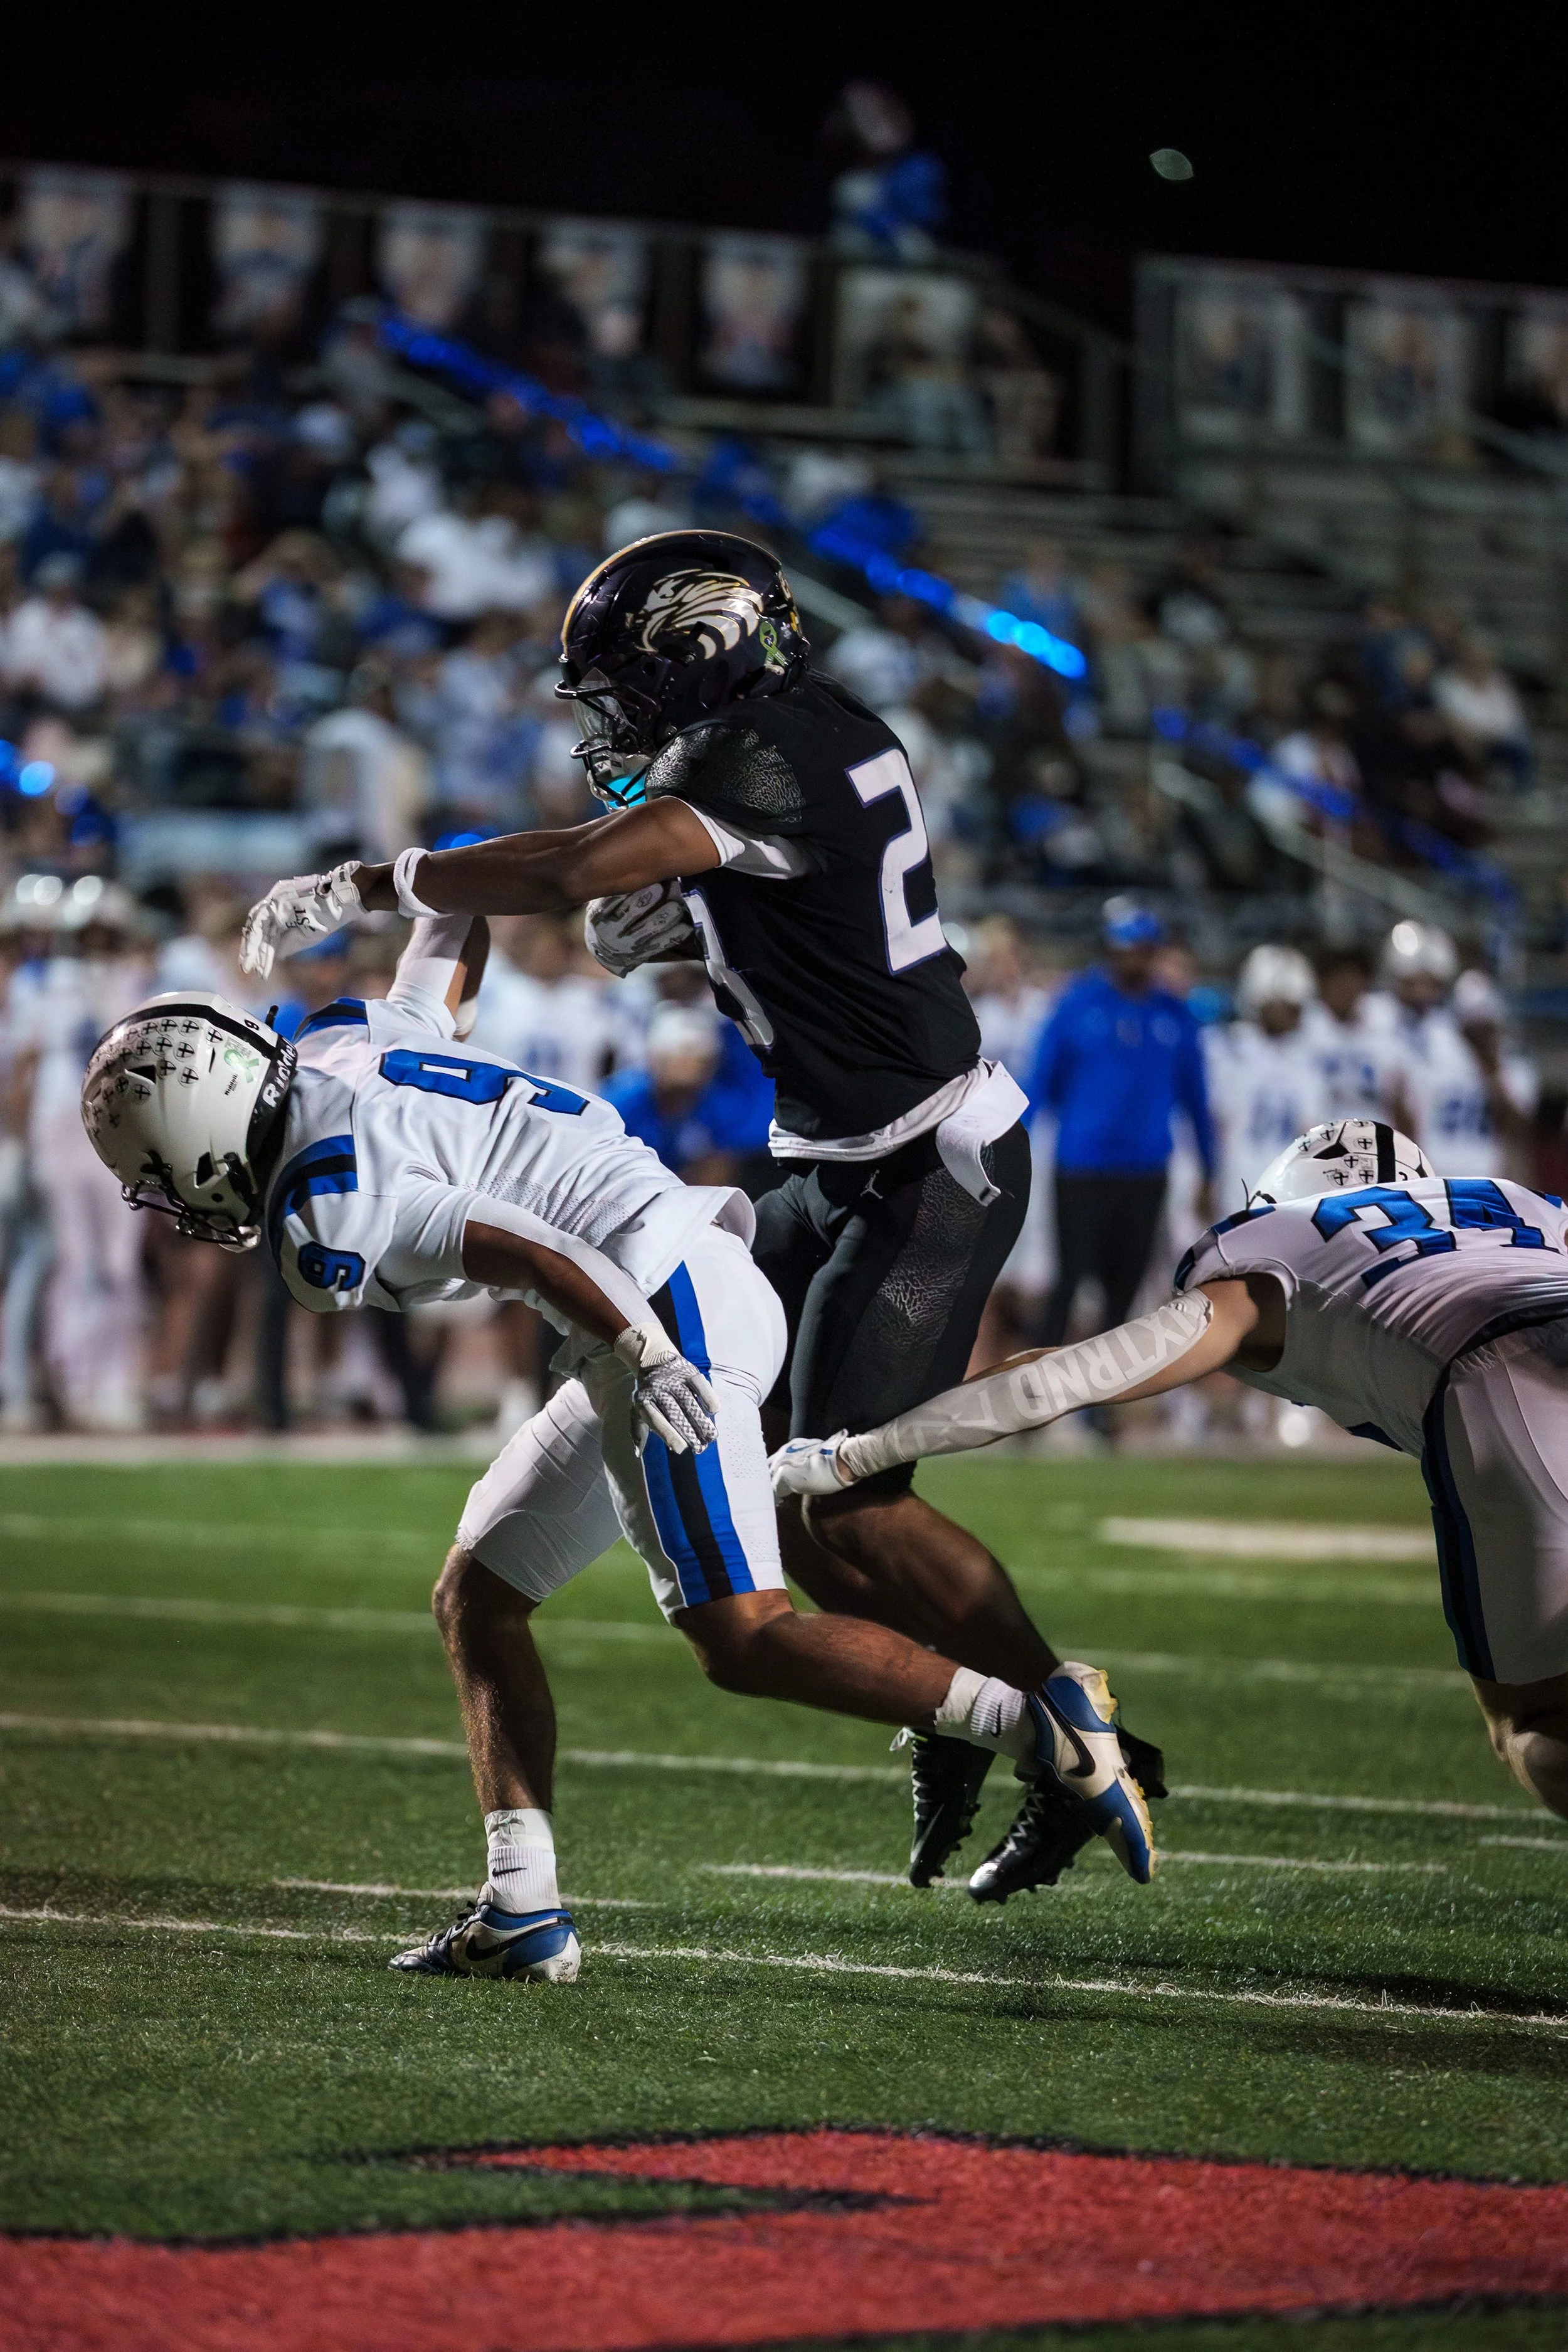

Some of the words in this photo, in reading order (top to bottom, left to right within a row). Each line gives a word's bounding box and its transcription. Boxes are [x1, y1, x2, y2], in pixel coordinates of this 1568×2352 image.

[844, 746, 949, 977] 2
[297, 1240, 366, 1291] 9
[1310, 1177, 1562, 1290] 34
